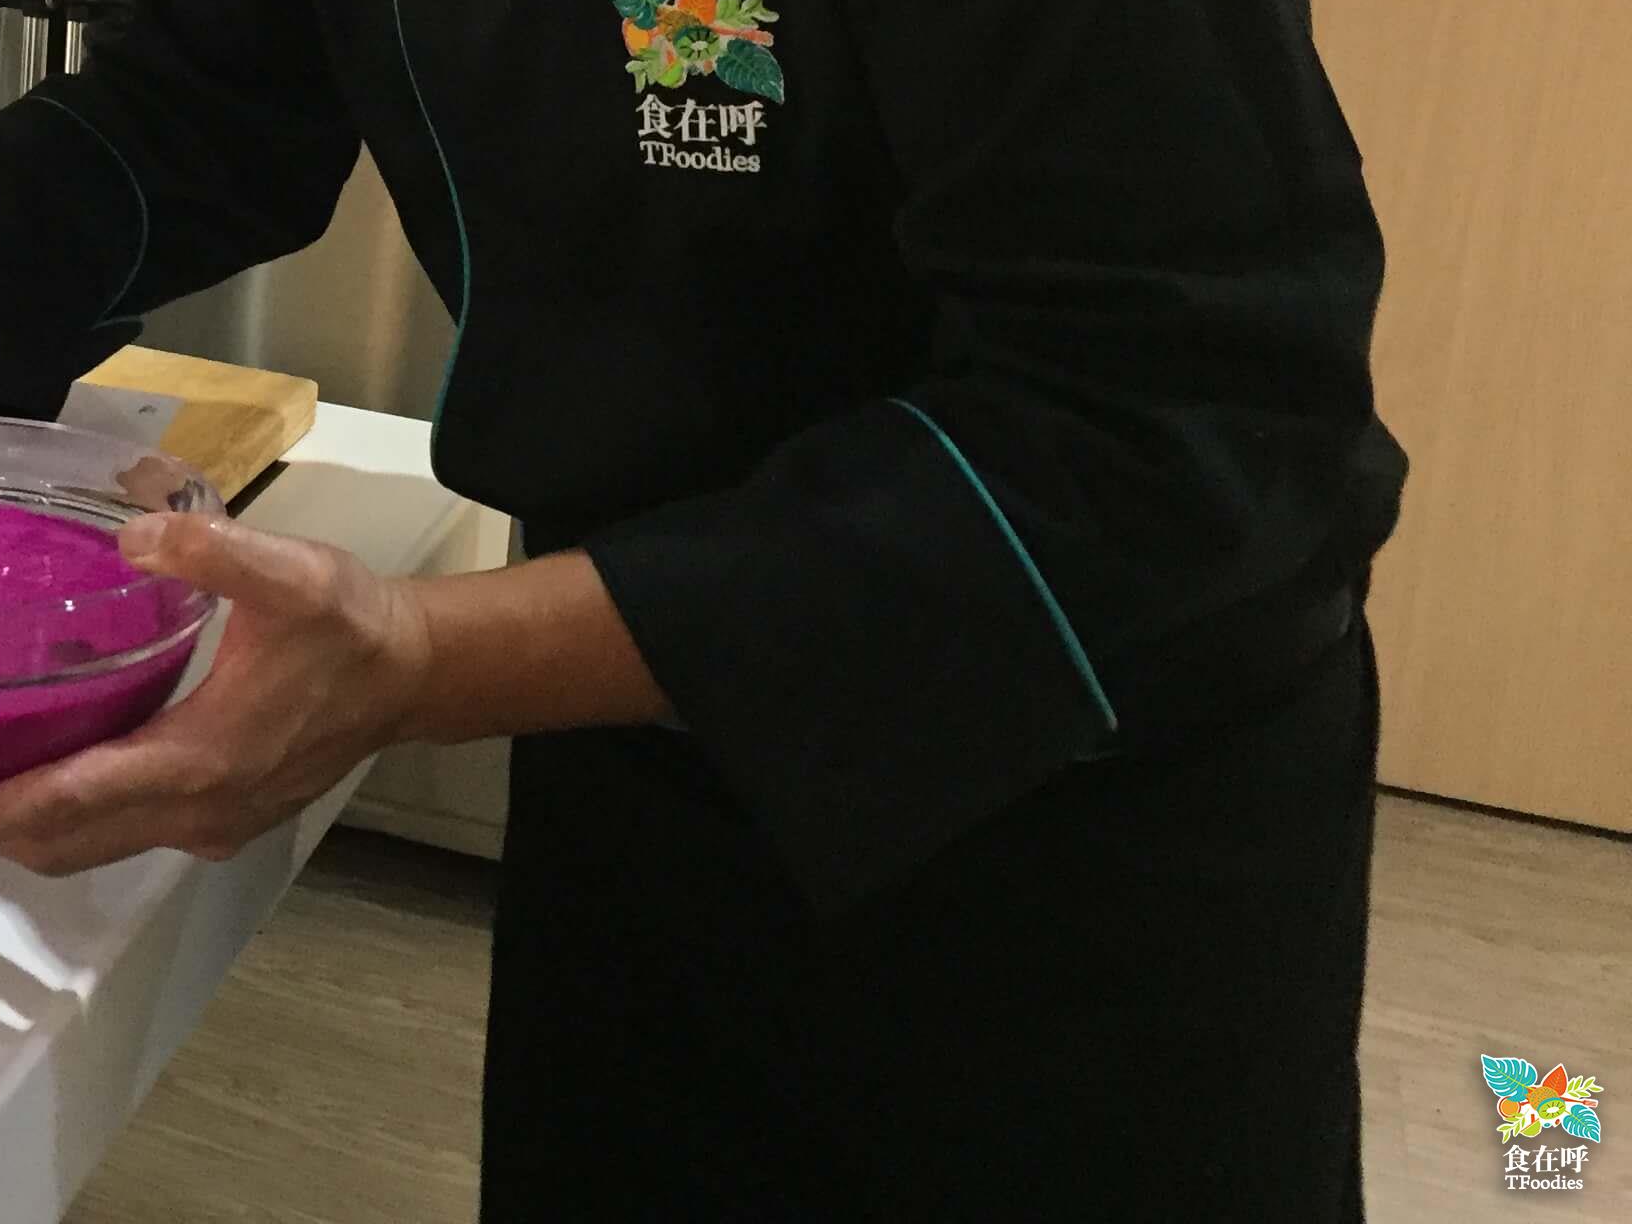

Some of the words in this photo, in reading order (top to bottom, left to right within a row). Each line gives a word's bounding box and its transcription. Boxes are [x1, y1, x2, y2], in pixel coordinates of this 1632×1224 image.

[635, 93, 768, 146] 食在呼
[639, 140, 761, 173] TFoodies
